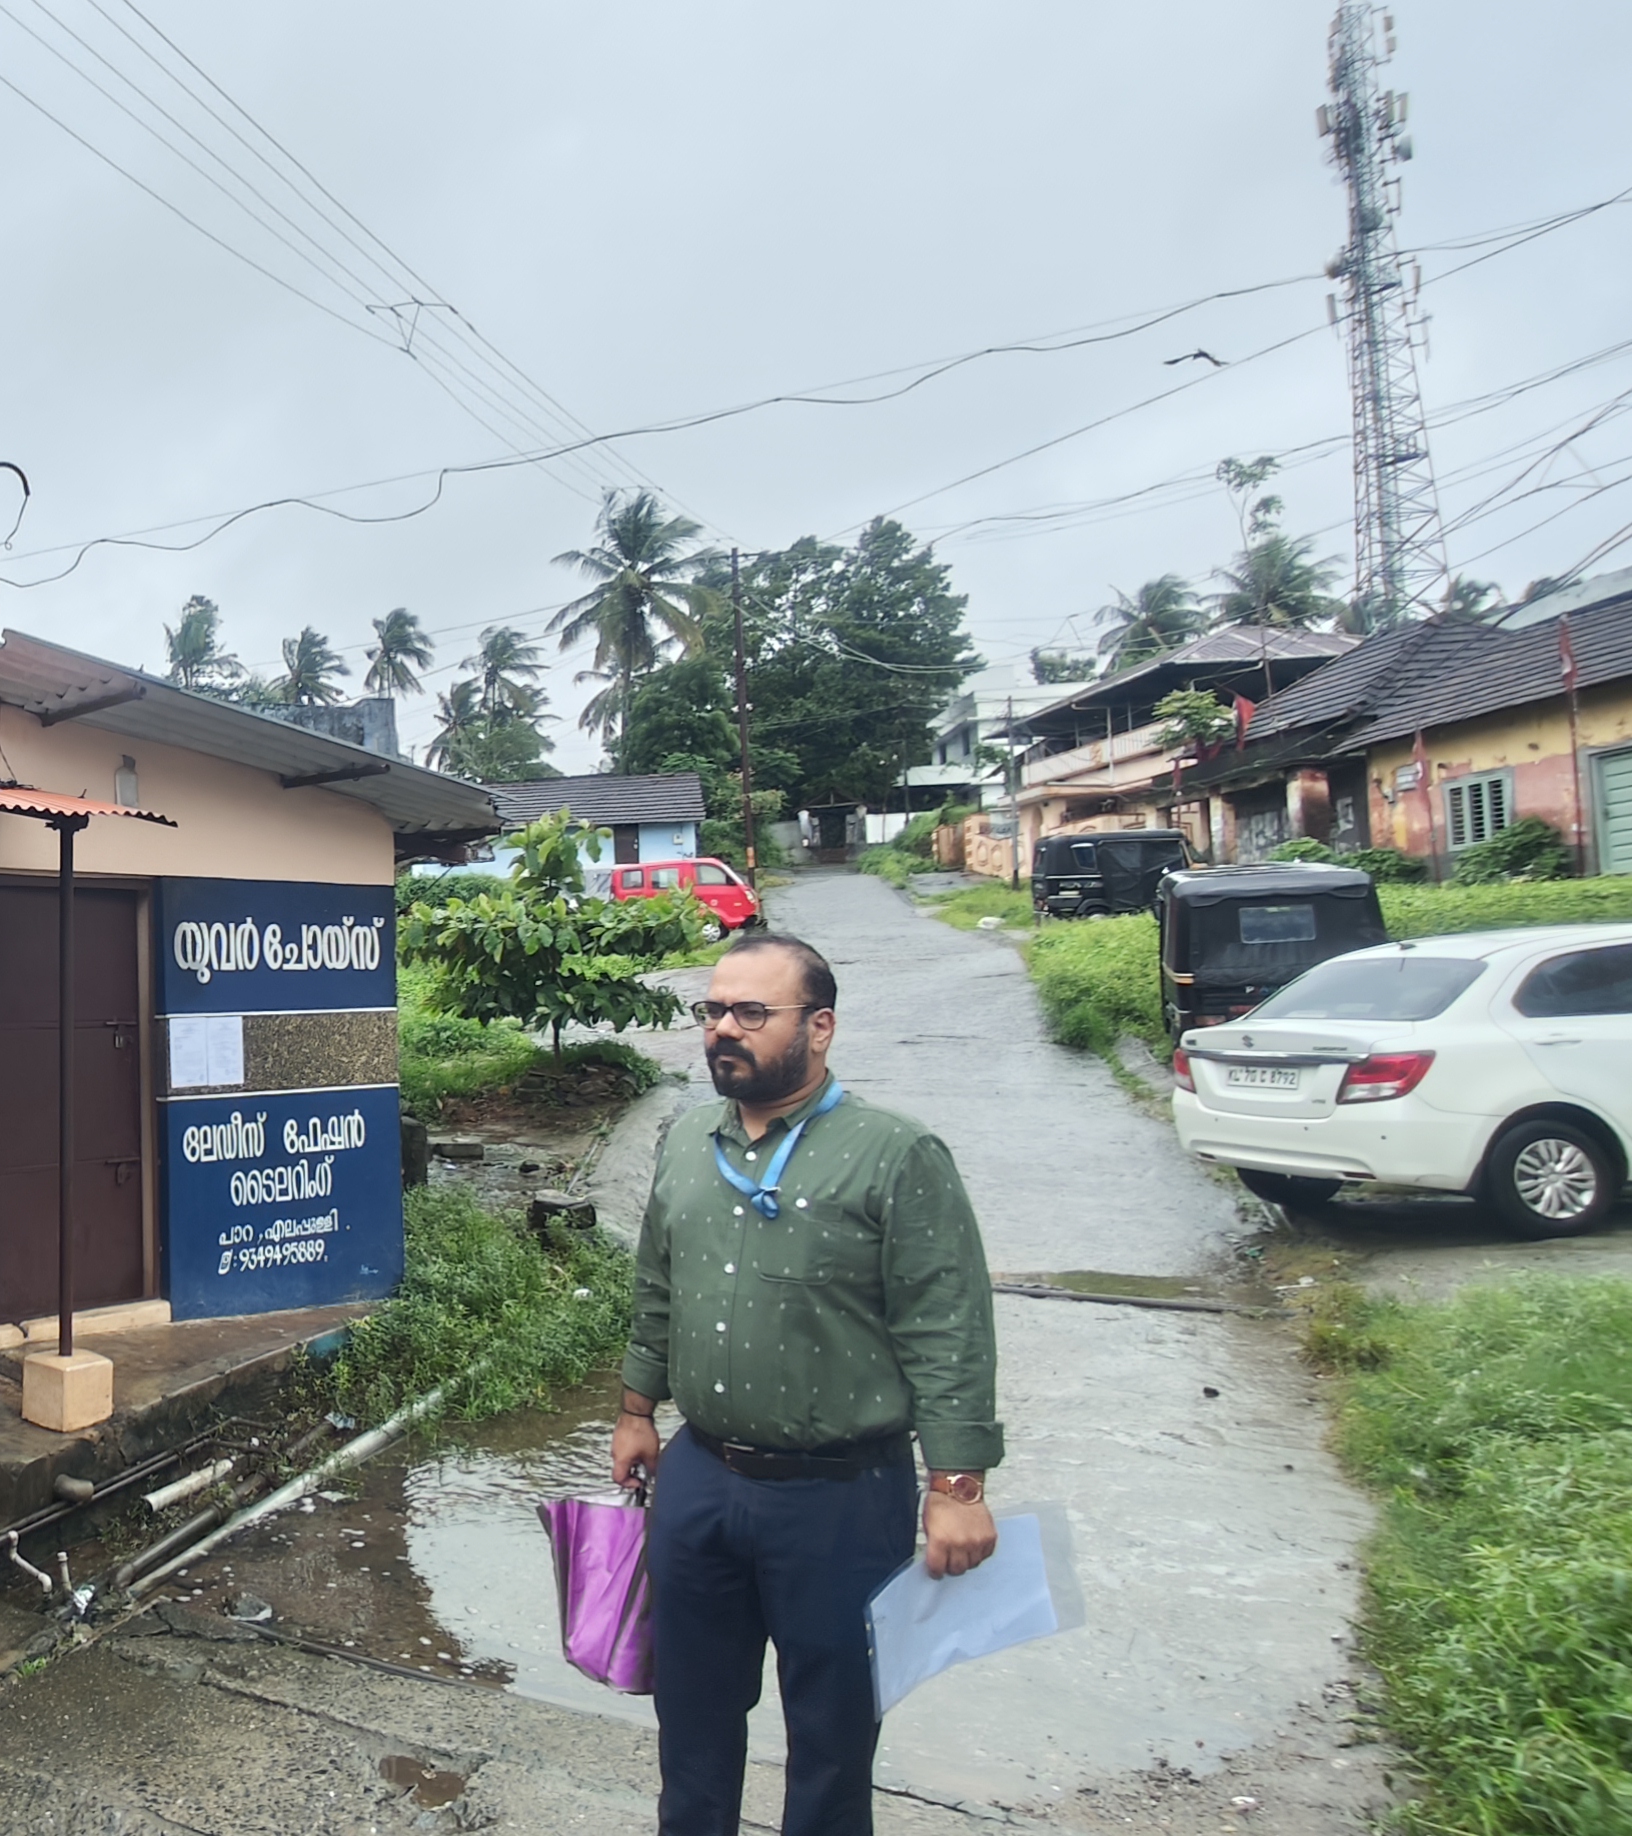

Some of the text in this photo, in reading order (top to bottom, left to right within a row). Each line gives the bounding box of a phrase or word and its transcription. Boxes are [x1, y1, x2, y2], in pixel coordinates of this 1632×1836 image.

[173, 917, 261, 985] യുവർ
[182, 1110, 268, 1164] ലേഡീസ്
[230, 1154, 335, 1207] ടൈലറിംഗ്
